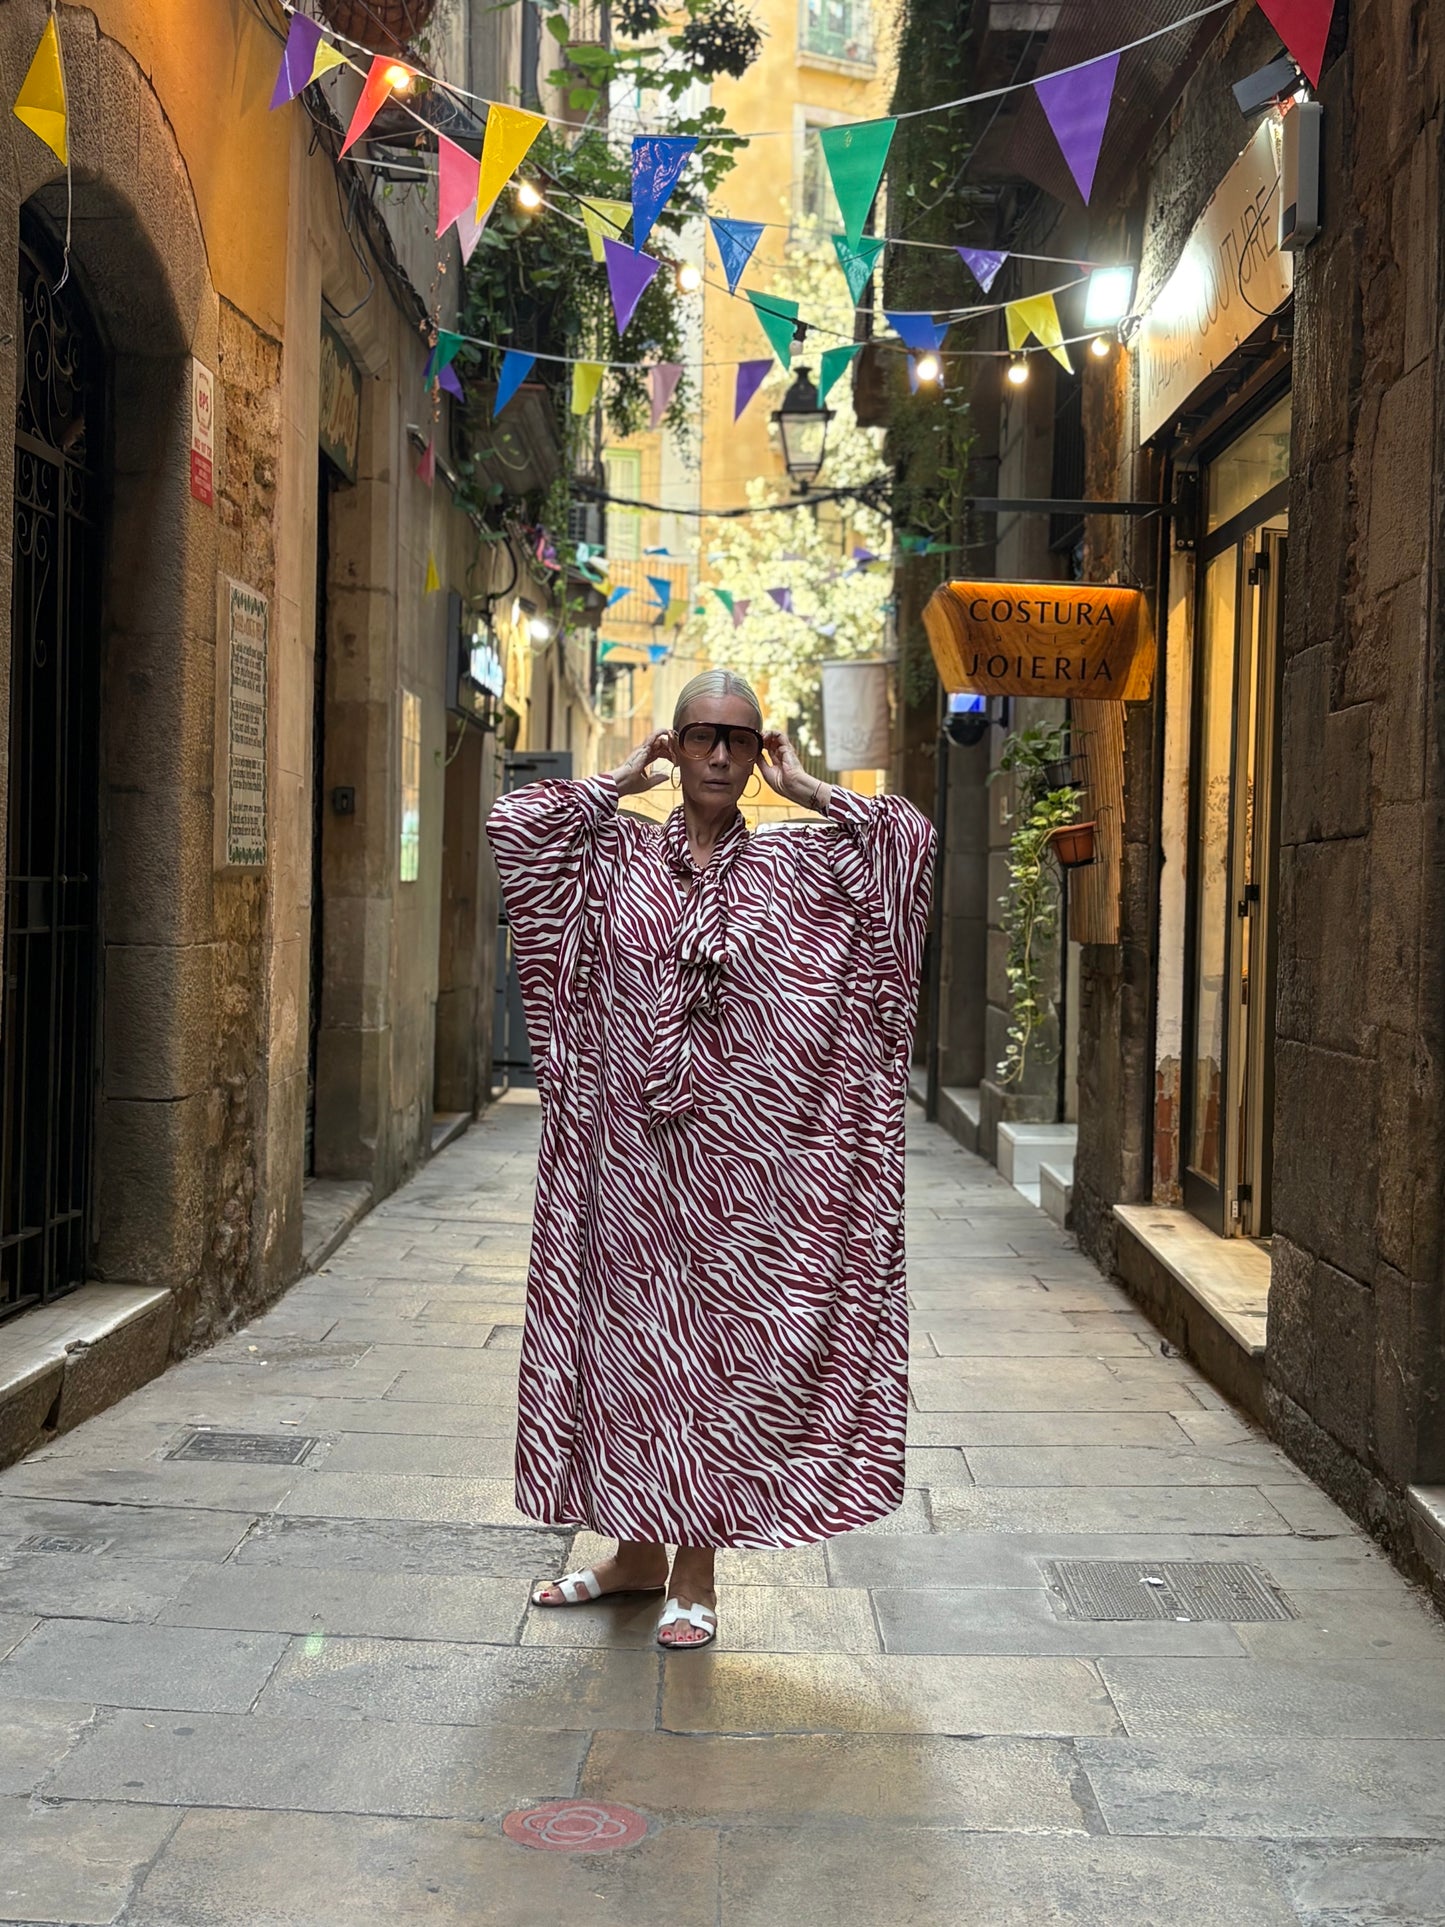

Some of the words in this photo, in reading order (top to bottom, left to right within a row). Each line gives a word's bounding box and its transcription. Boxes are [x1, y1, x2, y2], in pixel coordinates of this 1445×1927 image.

[1195, 184, 1278, 338] COUTURE
[969, 599, 1115, 626] COSTURA
[968, 632, 1115, 645] talle
[966, 654, 1112, 681] JOIERIA
